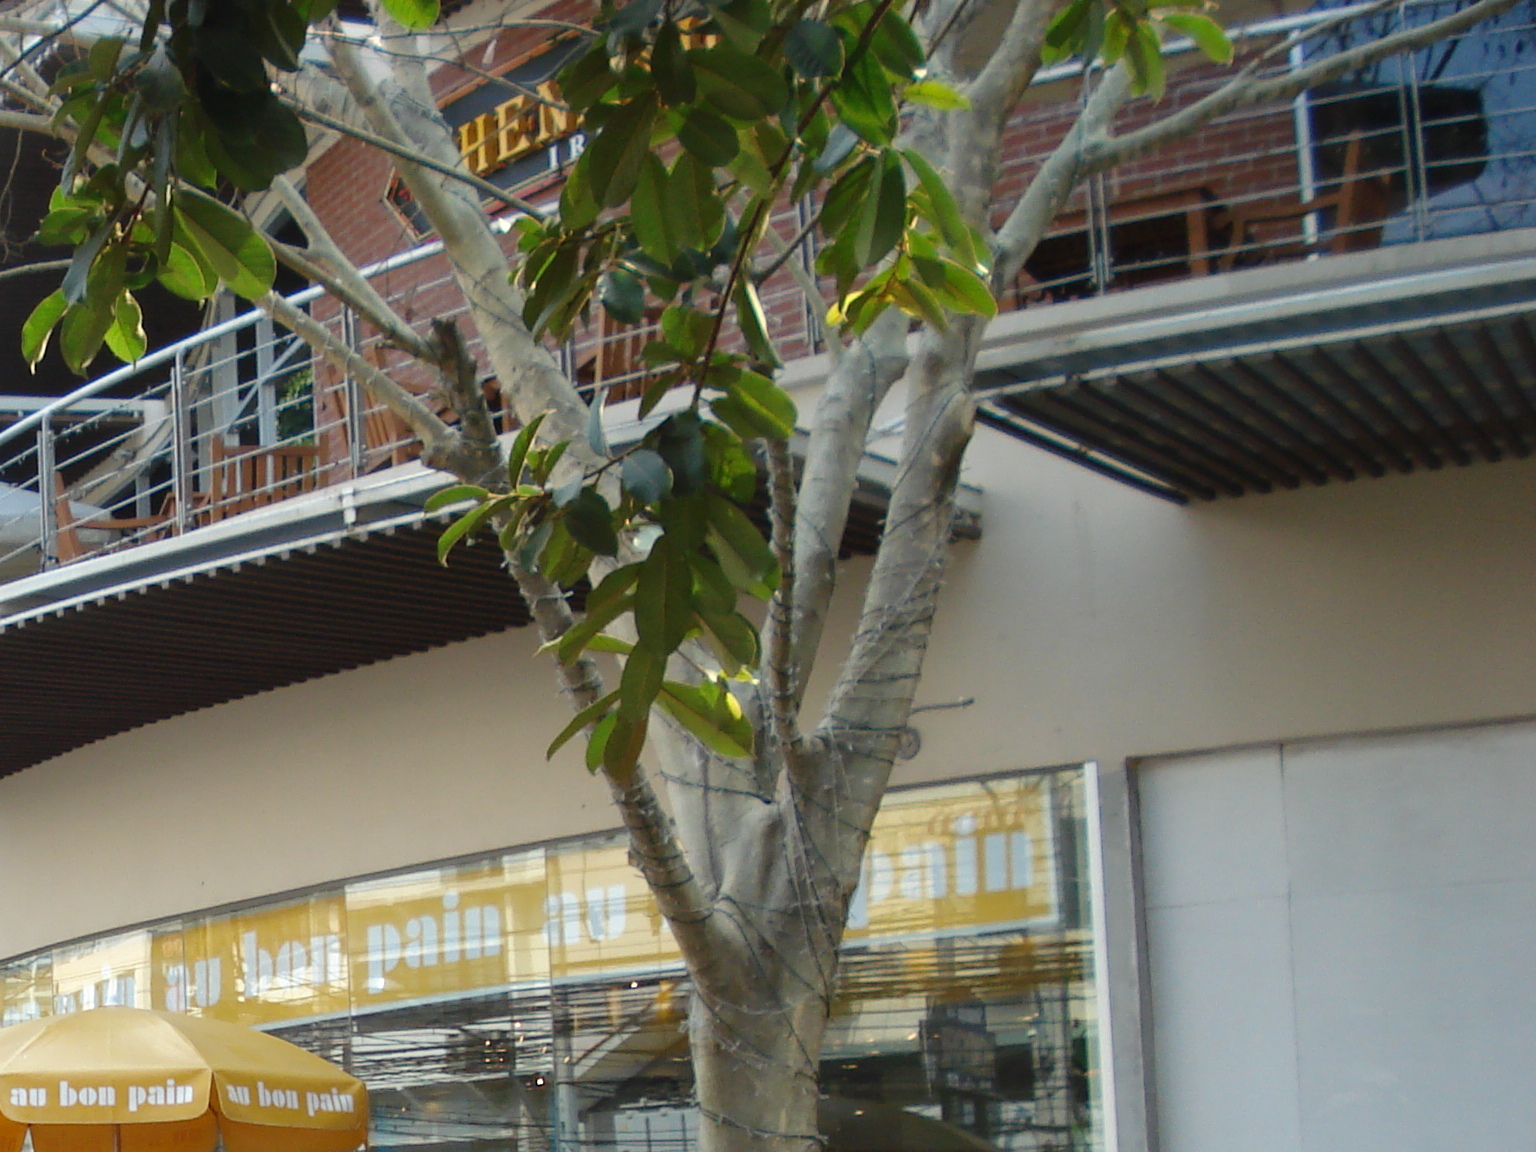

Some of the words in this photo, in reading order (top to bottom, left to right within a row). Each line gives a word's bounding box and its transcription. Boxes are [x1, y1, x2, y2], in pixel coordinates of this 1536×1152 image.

[458, 79, 585, 178] HEN
[166, 957, 222, 1013] au
[242, 930, 341, 999] bon
[366, 889, 501, 995] pain
[9, 1087, 46, 1107] au
[59, 1080, 116, 1107] bon
[128, 1078, 194, 1113] pain
[226, 1084, 250, 1106] au
[257, 1081, 299, 1109] bon
[306, 1087, 355, 1117] pain
